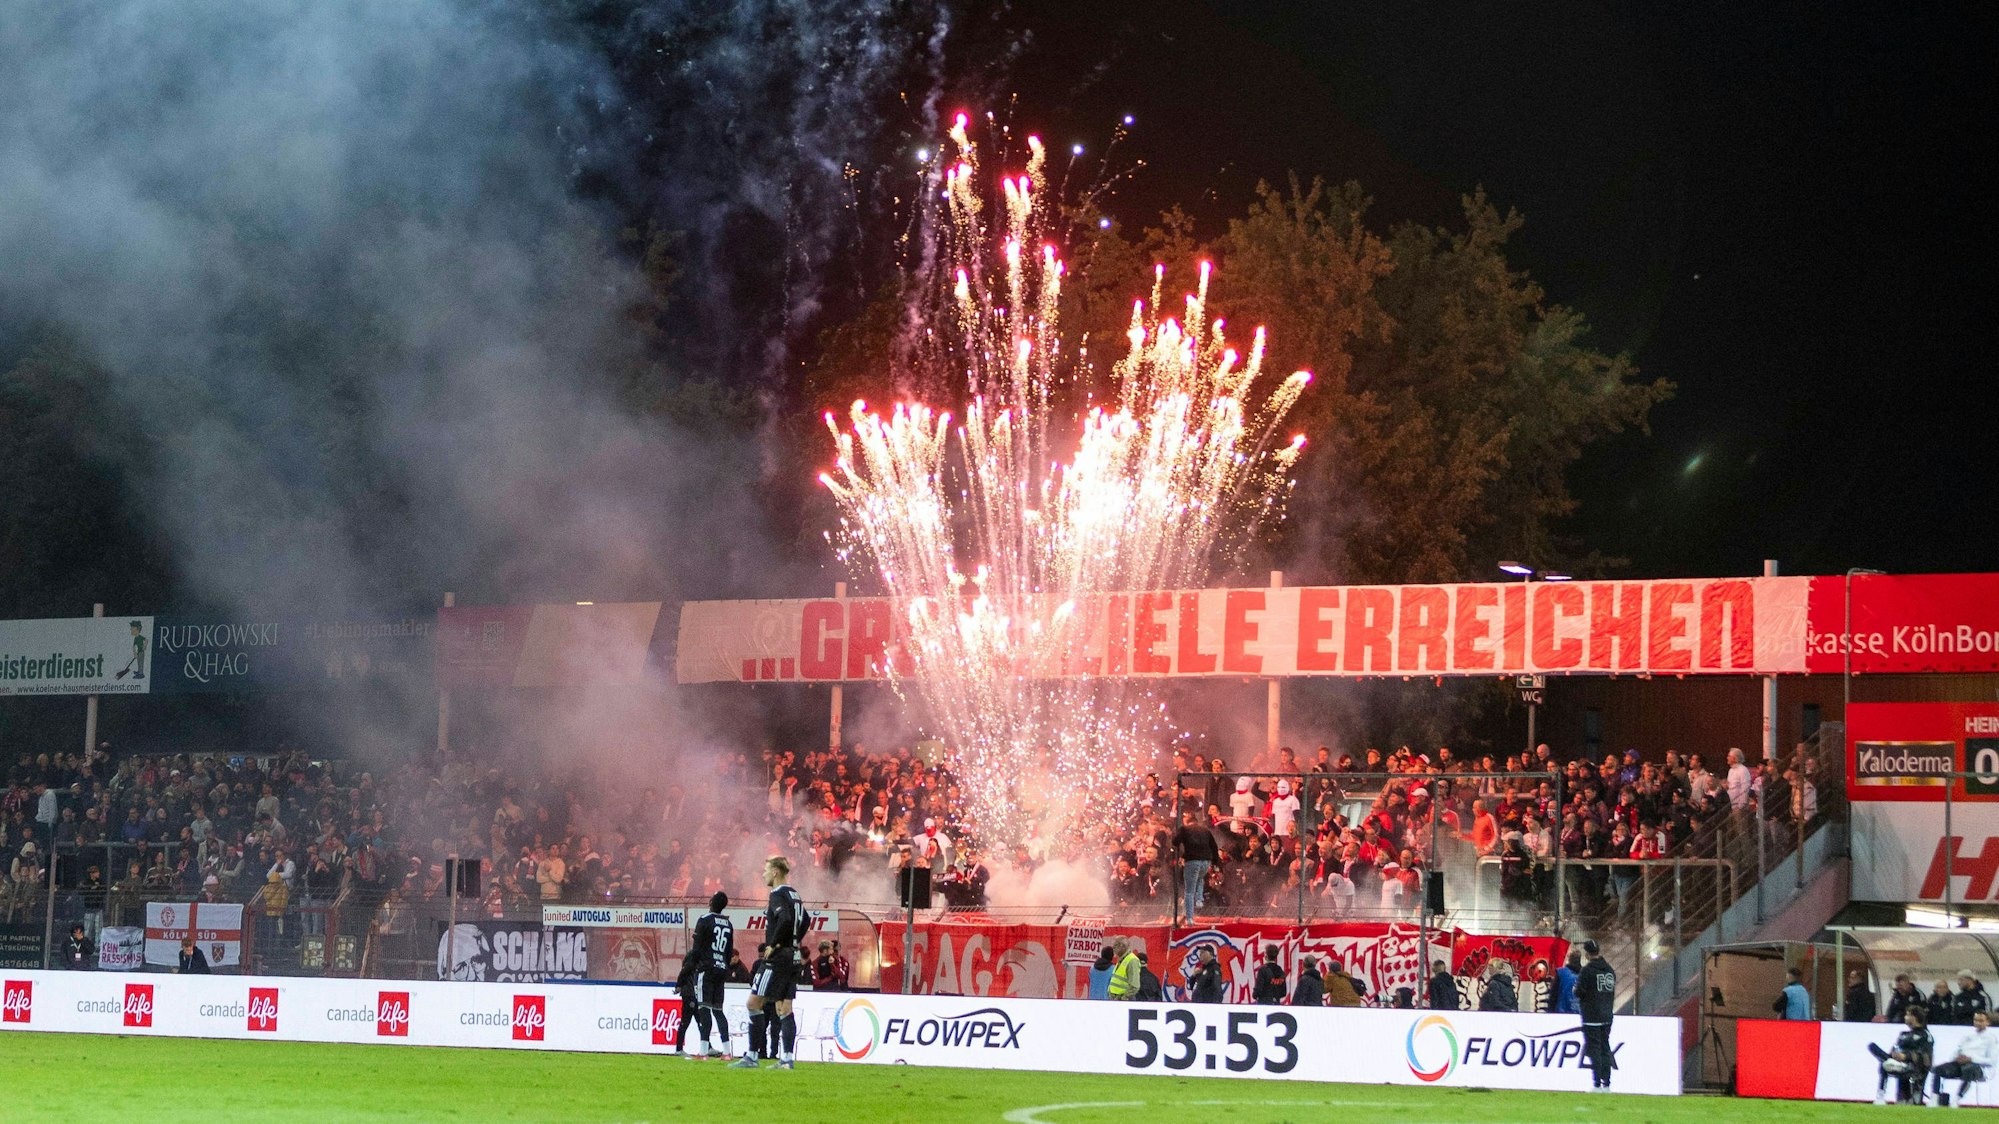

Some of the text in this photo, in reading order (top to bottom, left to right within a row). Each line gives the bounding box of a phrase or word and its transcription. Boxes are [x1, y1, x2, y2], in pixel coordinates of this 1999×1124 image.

[160, 623, 279, 653] RUDKOWSKI
[1297, 580, 1754, 671] ERREICHEN
[1521, 690, 1540, 702] WC
[1859, 748, 1952, 774] Kaloderma
[544, 909, 611, 922] junited AUTOGLAS
[615, 910, 684, 924] junited AUTOGLAS
[163, 930, 217, 940] KÖLN SÜD
[712, 926, 730, 953] 36
[1067, 939, 1102, 953] VERBOT
[1068, 927, 1104, 939] STADION
[102, 942, 118, 953] KEIN
[3, 989, 32, 1020] life
[77, 993, 154, 1024] canada life
[199, 996, 278, 1028] canada life
[327, 1000, 410, 1033] canada life
[460, 1004, 546, 1038] canada life
[598, 1013, 649, 1031] canada
[883, 1010, 1026, 1049] FLOWPEX
[1125, 1009, 1298, 1074] 53:53
